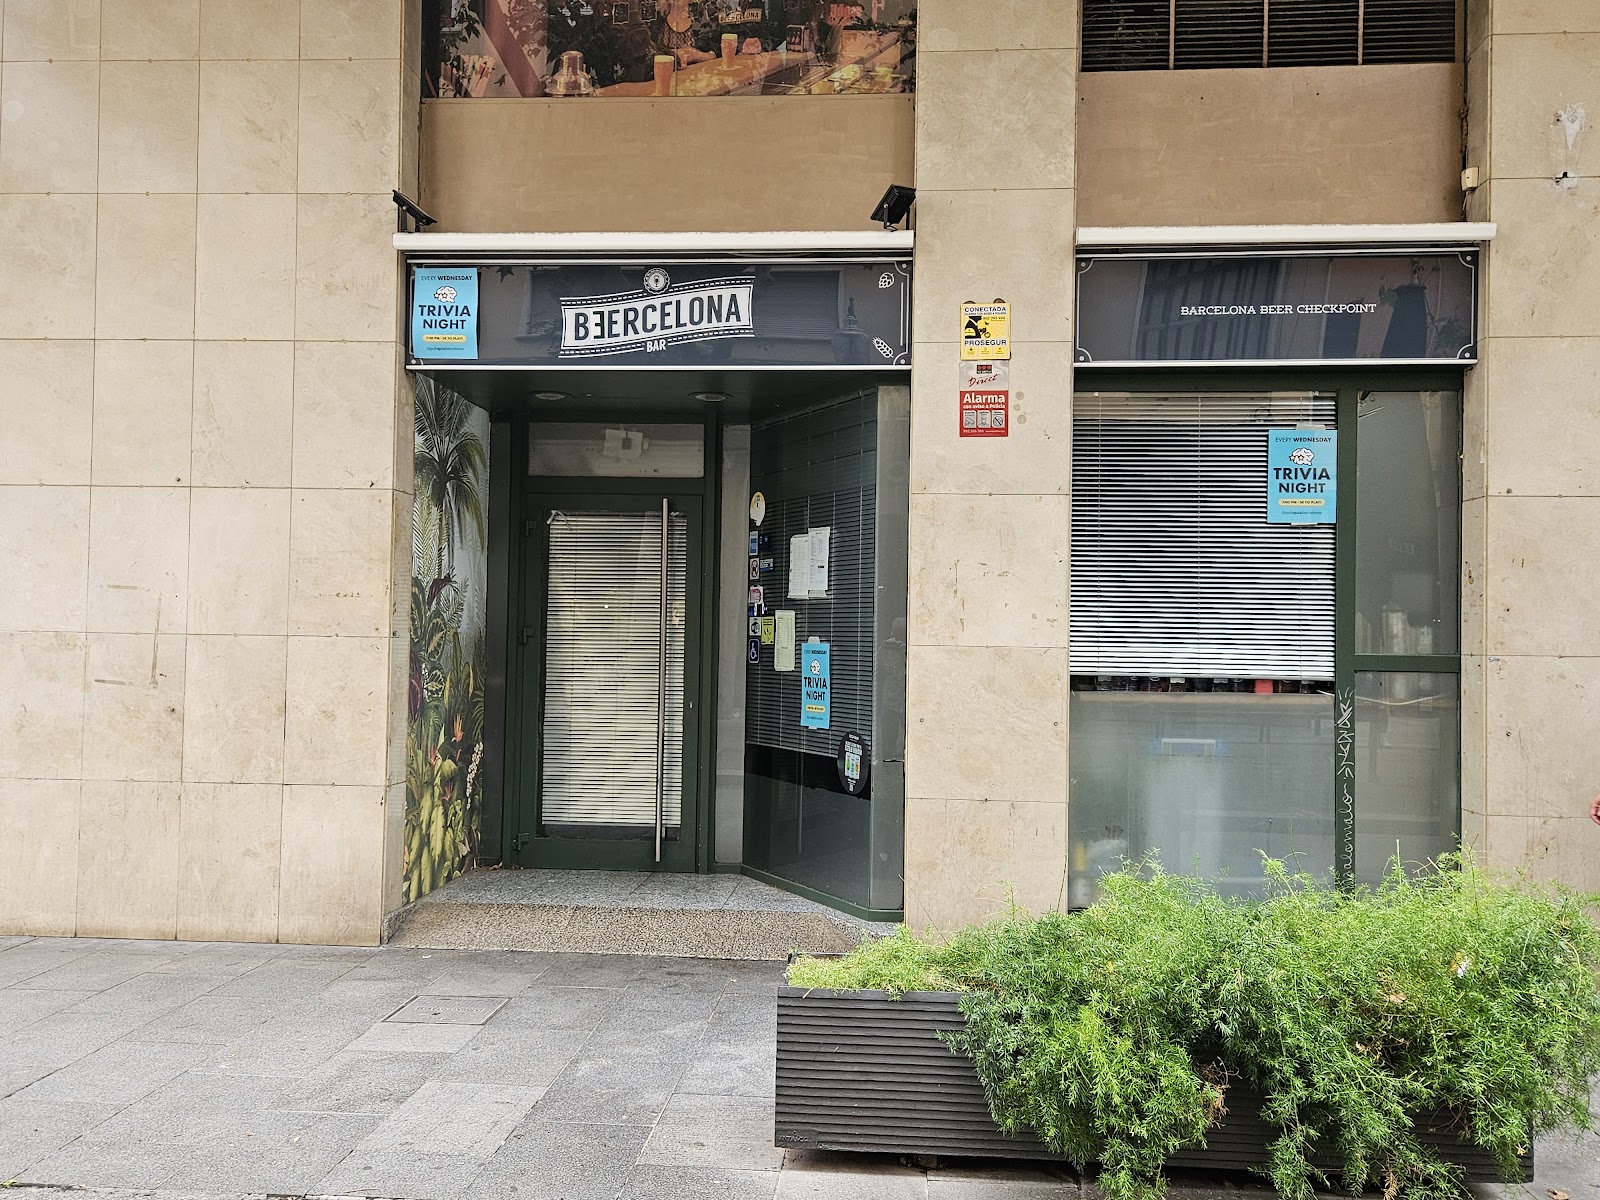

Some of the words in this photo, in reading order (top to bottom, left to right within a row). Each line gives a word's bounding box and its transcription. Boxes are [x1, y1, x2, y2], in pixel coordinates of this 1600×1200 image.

[418, 305, 471, 317] TRIVIA
[1180, 305, 1256, 316] BARCELONA
[1260, 305, 1293, 315] BEER
[1297, 303, 1377, 314] CHECKPOINT
[423, 319, 467, 329] NIGHT
[646, 339, 667, 353] BAR
[963, 392, 1005, 404] Alarma
[1273, 467, 1331, 480] TRIVIA
[1279, 482, 1326, 493] NIGHT
[803, 676, 828, 690] TRIVIA
[806, 690, 826, 701] NIGHT
